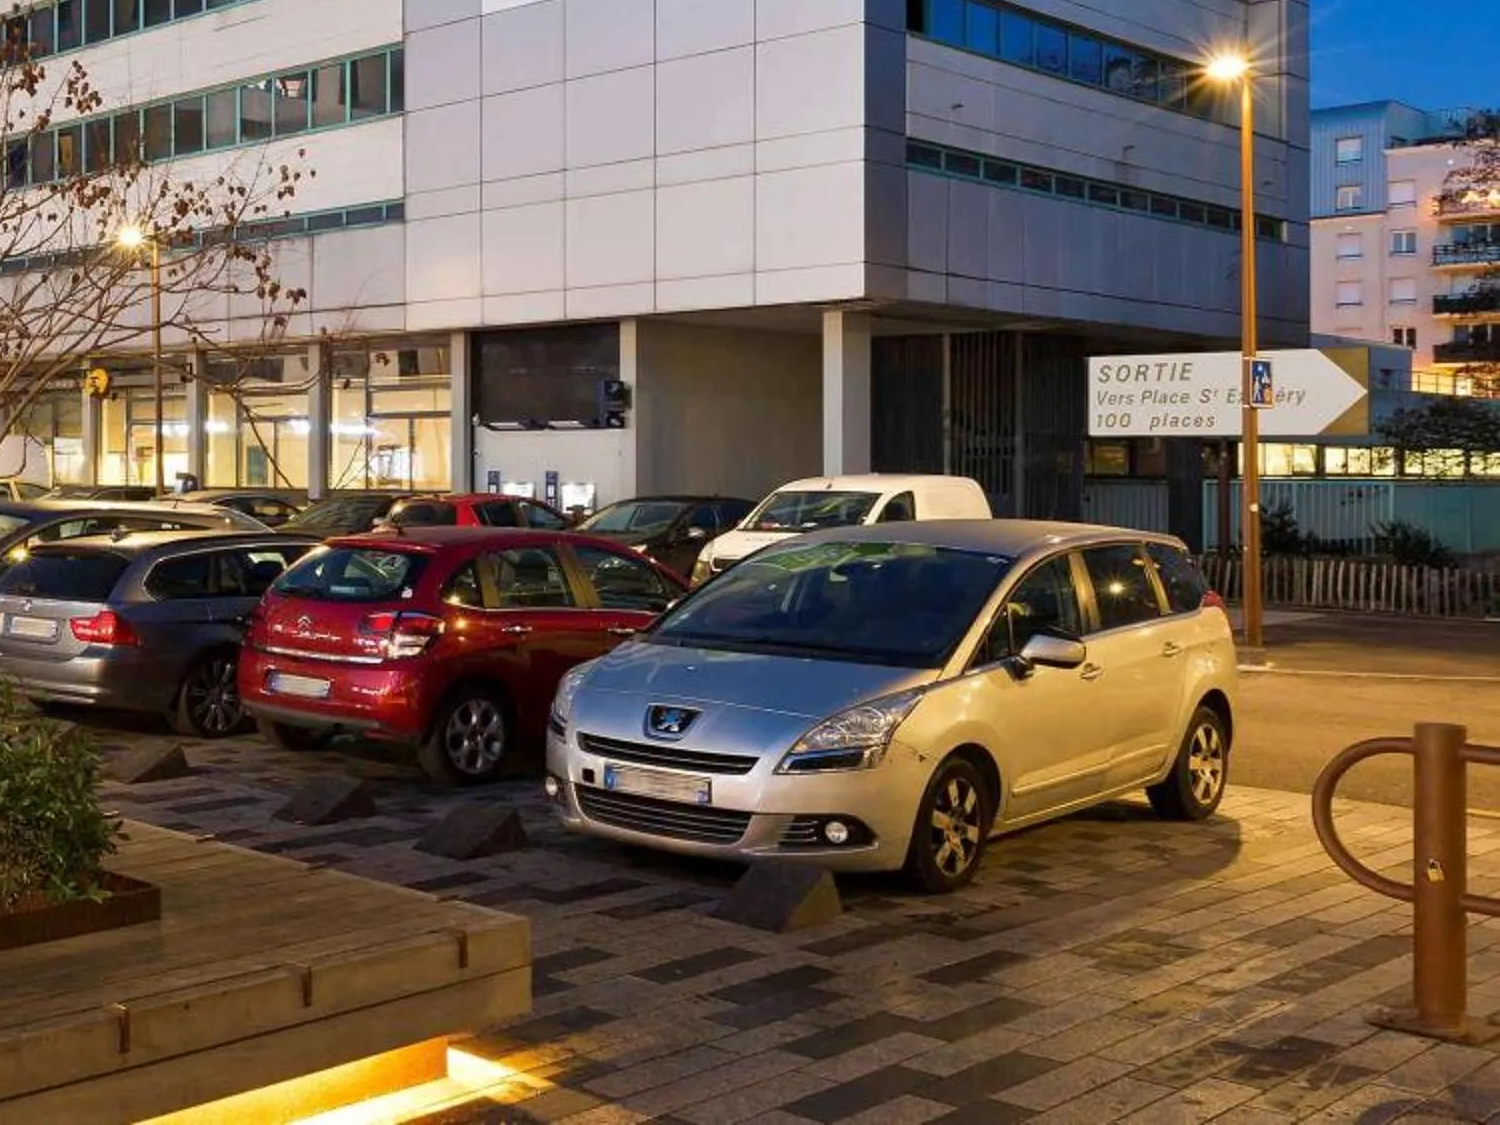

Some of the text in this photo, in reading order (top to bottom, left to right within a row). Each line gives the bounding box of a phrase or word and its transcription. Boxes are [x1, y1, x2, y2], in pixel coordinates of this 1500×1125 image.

[1098, 362, 1193, 383] SORTIE
[1096, 390, 1134, 405] Vers
[1141, 388, 1189, 404] Place
[1199, 388, 1219, 404] St
[1096, 412, 1216, 432] 100 places
